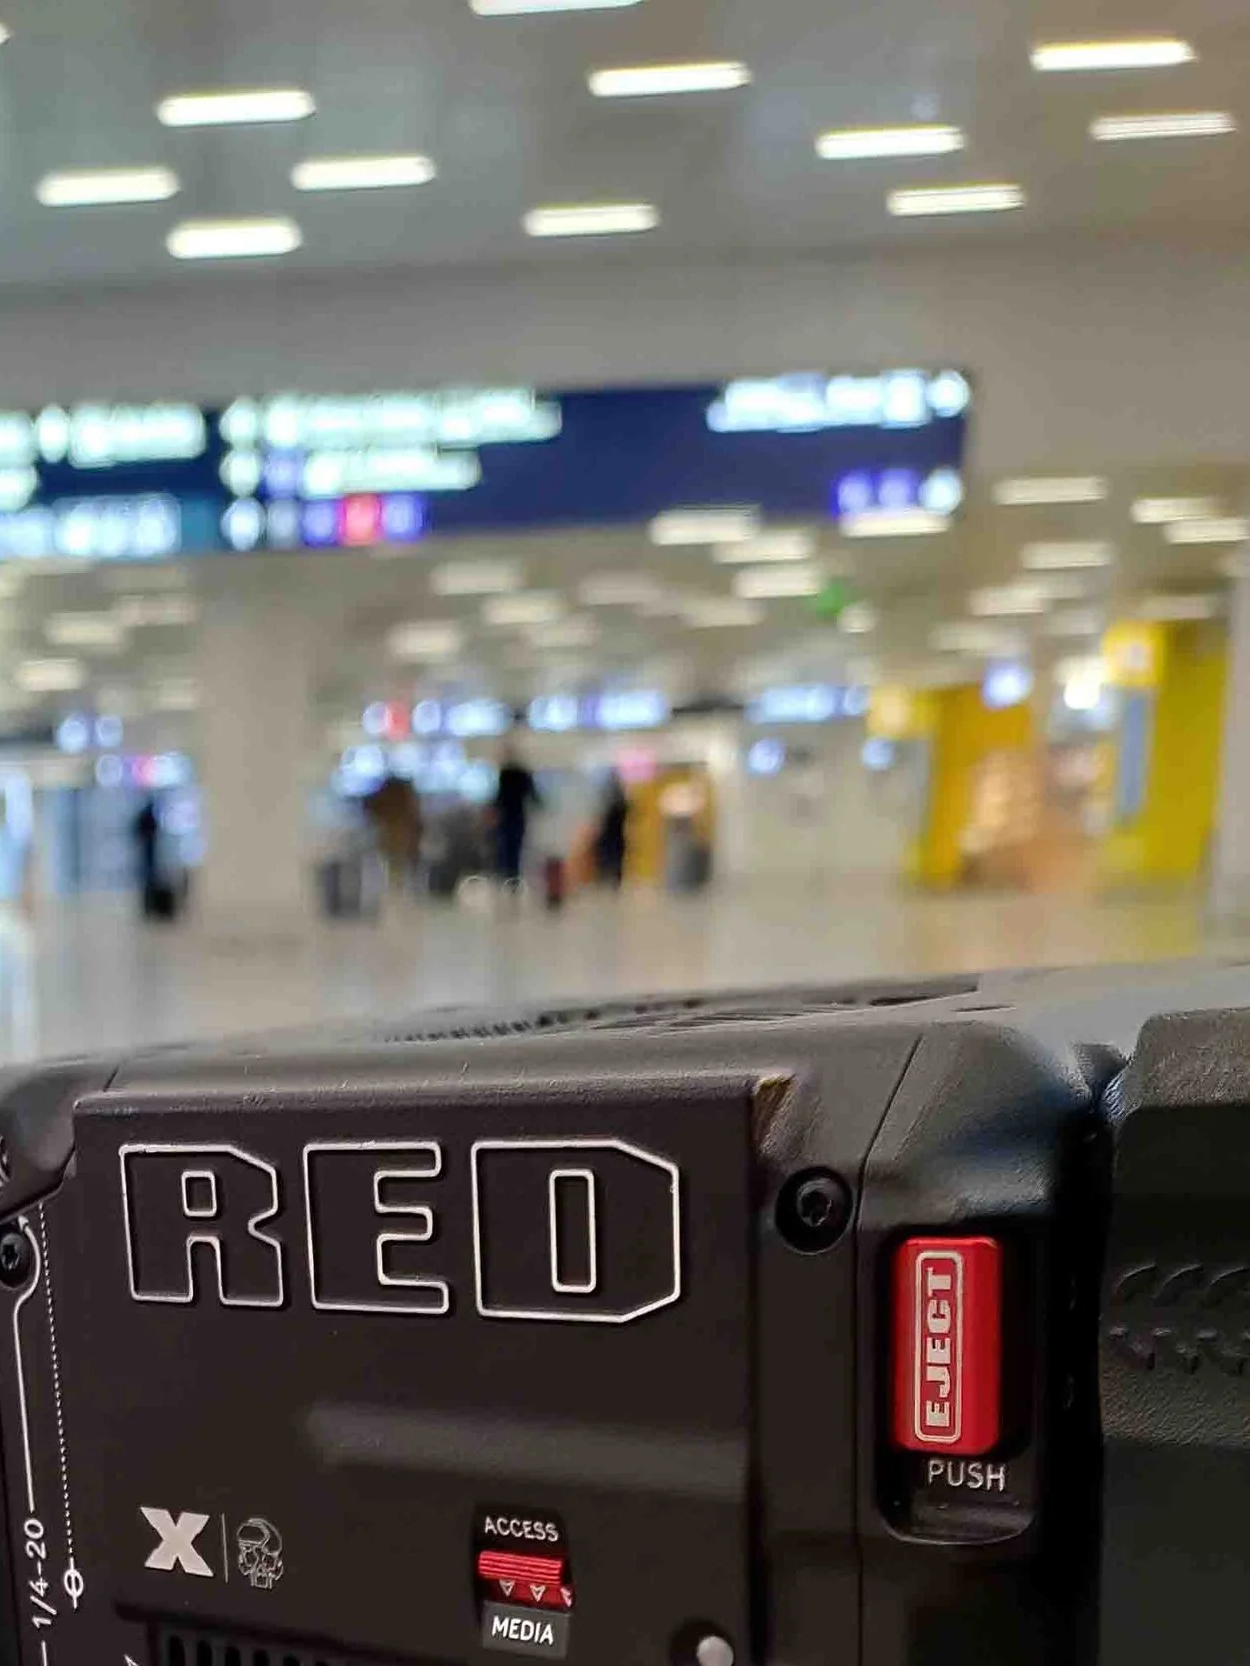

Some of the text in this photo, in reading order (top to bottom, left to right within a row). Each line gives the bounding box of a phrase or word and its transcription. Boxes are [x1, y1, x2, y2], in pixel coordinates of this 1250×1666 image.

[119, 1139, 680, 1323] RED
[925, 1266, 951, 1428] EJECT
[927, 1458, 1006, 1491] PUSH
[484, 1515, 559, 1542] ACCESS
[23, 1517, 58, 1629] 1/4-20
[491, 1614, 555, 1646] MEDIA
